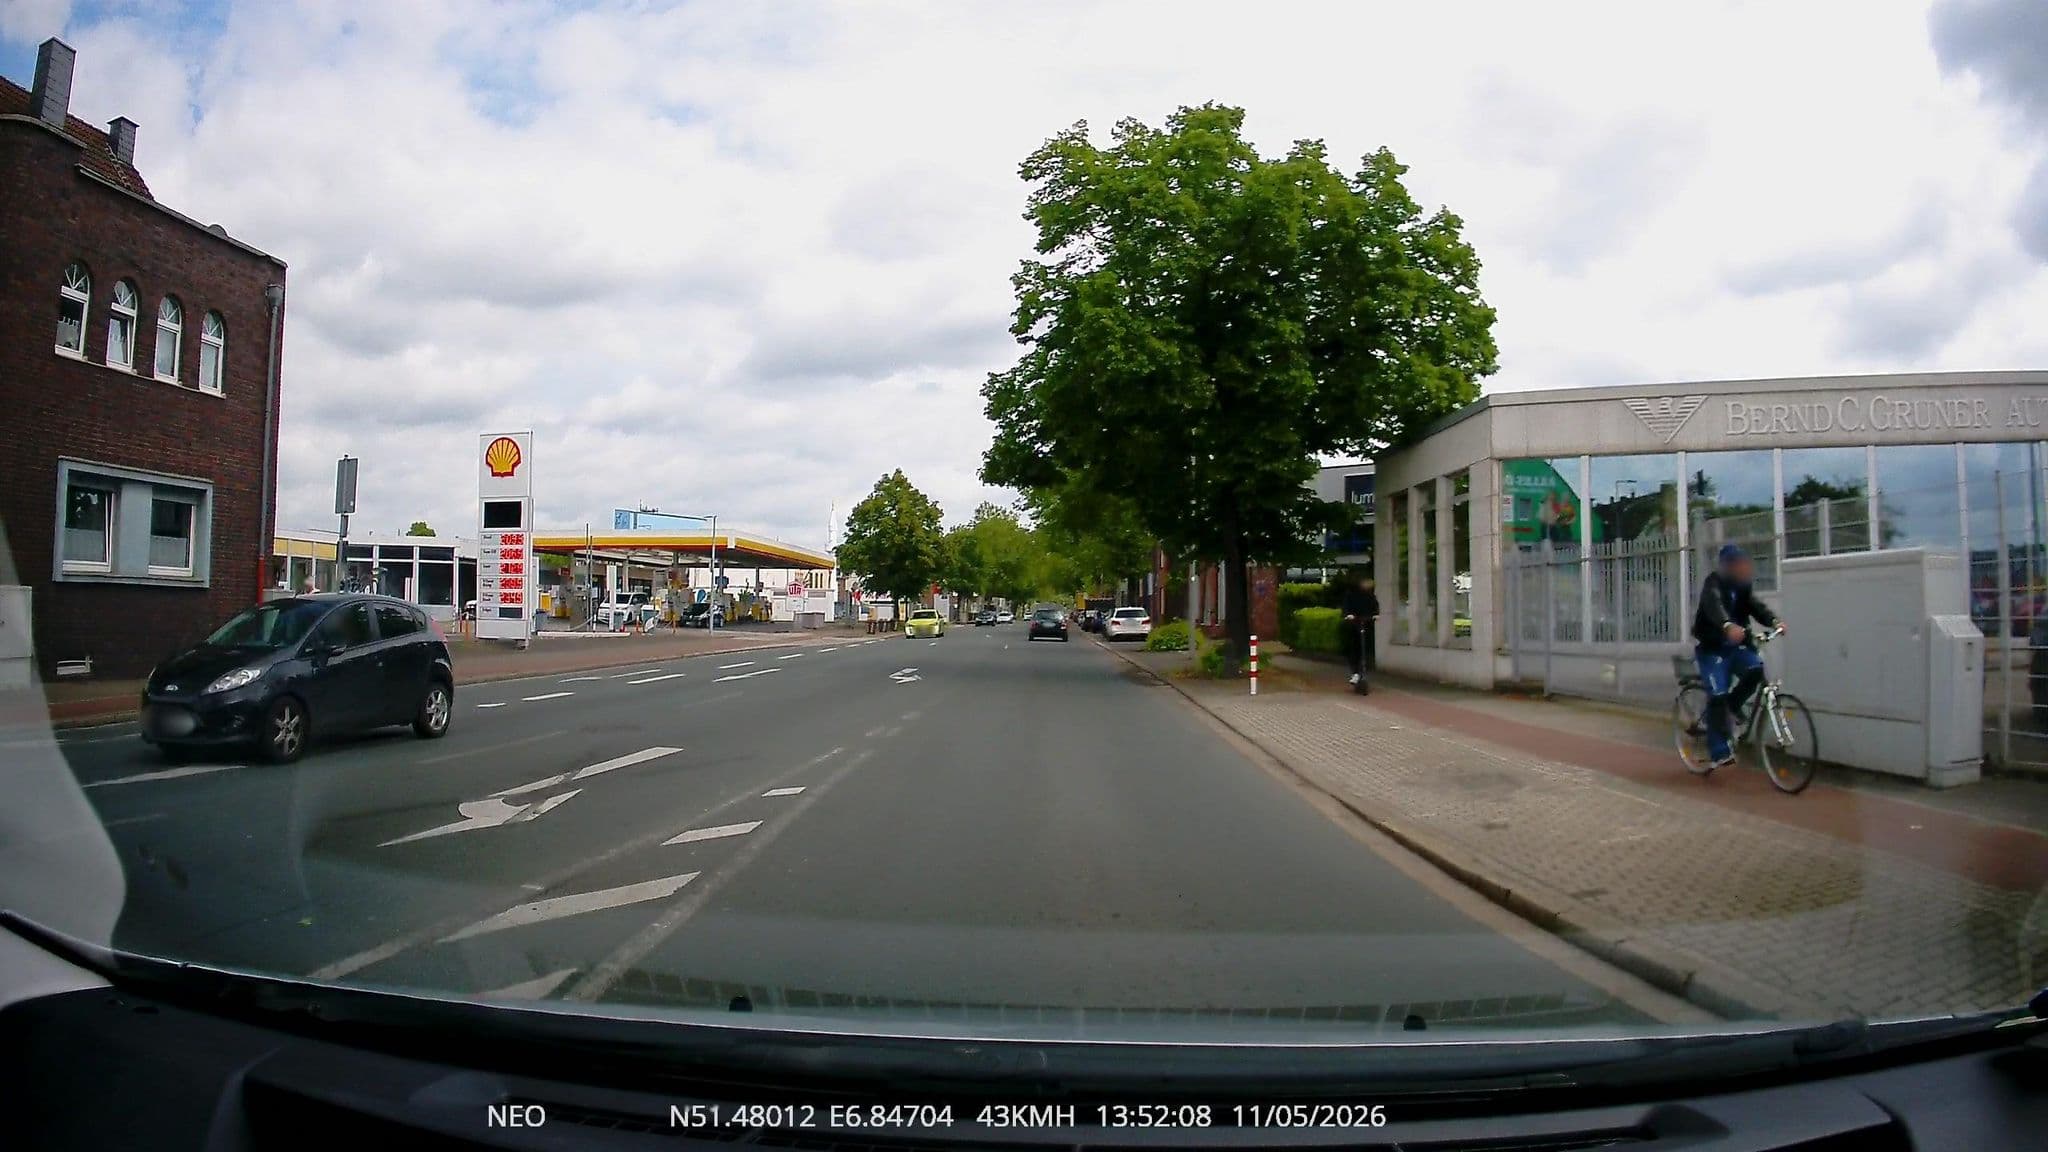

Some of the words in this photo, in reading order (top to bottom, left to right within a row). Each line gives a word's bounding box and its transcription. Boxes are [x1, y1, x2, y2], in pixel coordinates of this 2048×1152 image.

[1725, 400, 1832, 436] BERND
[1838, 396, 1867, 432] C.
[1870, 395, 1992, 431] GRUNER
